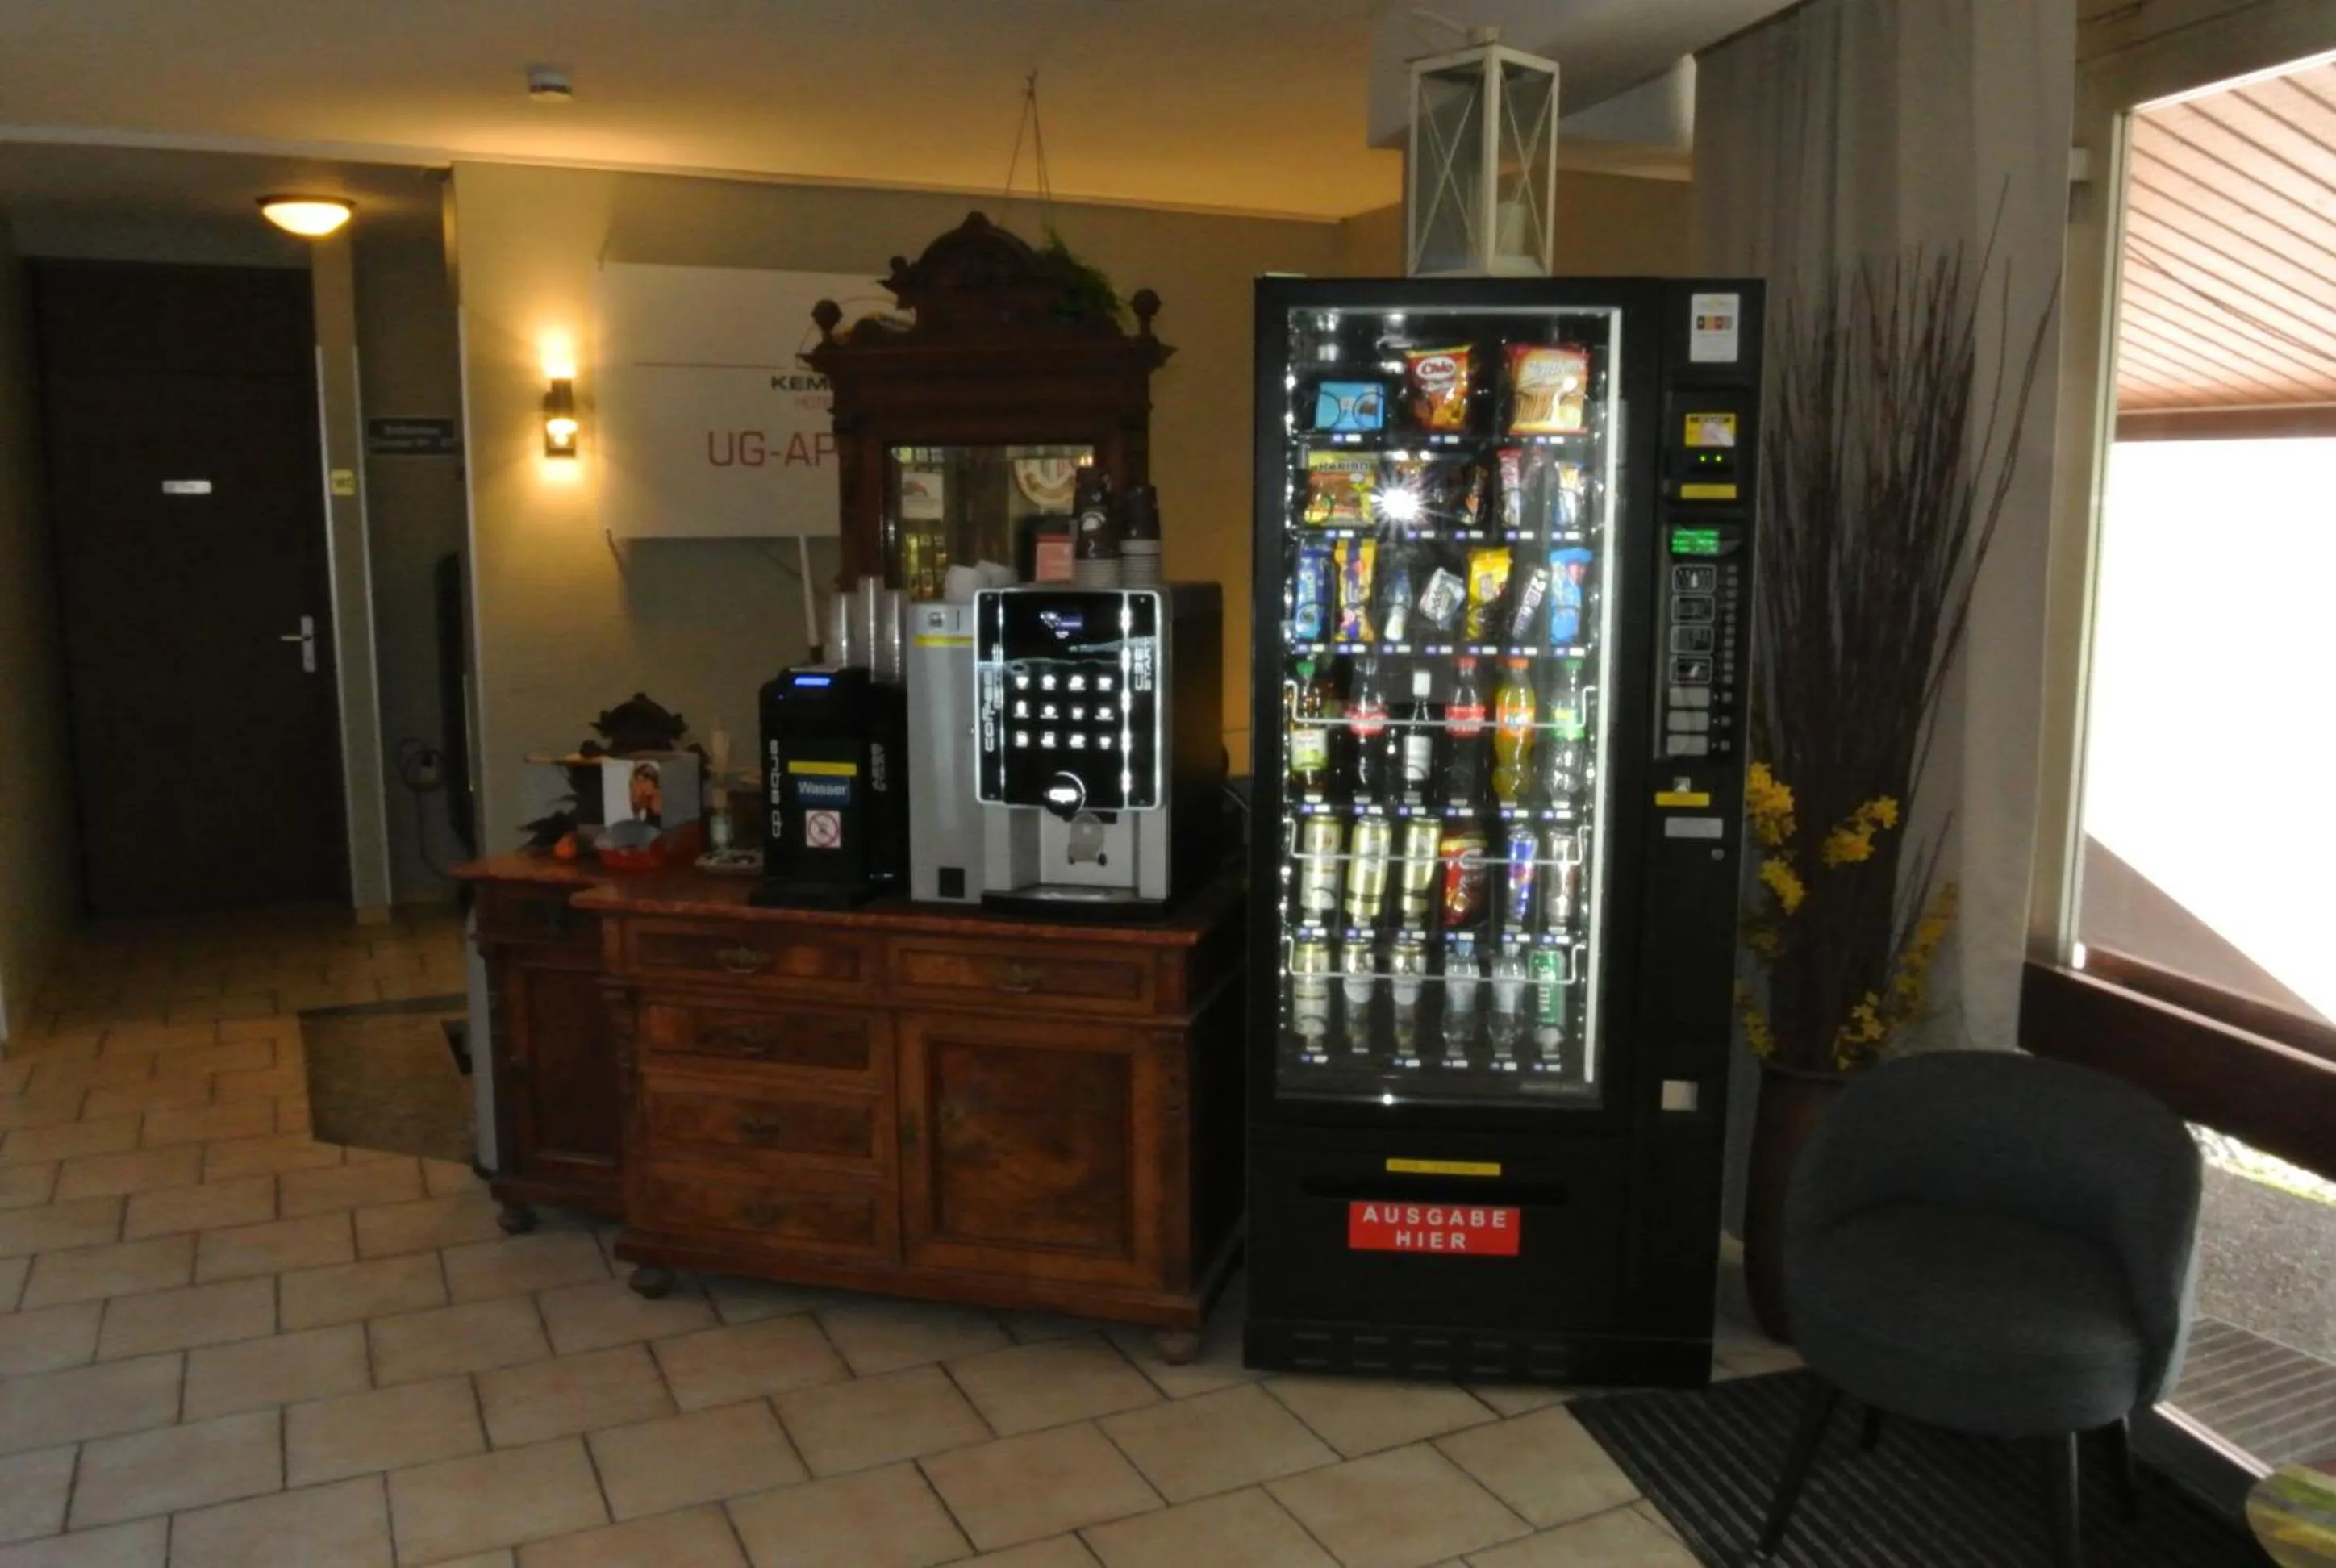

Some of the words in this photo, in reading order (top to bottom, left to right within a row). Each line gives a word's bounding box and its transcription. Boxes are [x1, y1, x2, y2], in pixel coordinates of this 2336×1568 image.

[771, 375, 832, 391] KEM
[797, 780, 848, 797] Wasser
[1363, 1205, 1507, 1228] AUSGABE
[1396, 1231, 1466, 1249] HIER
